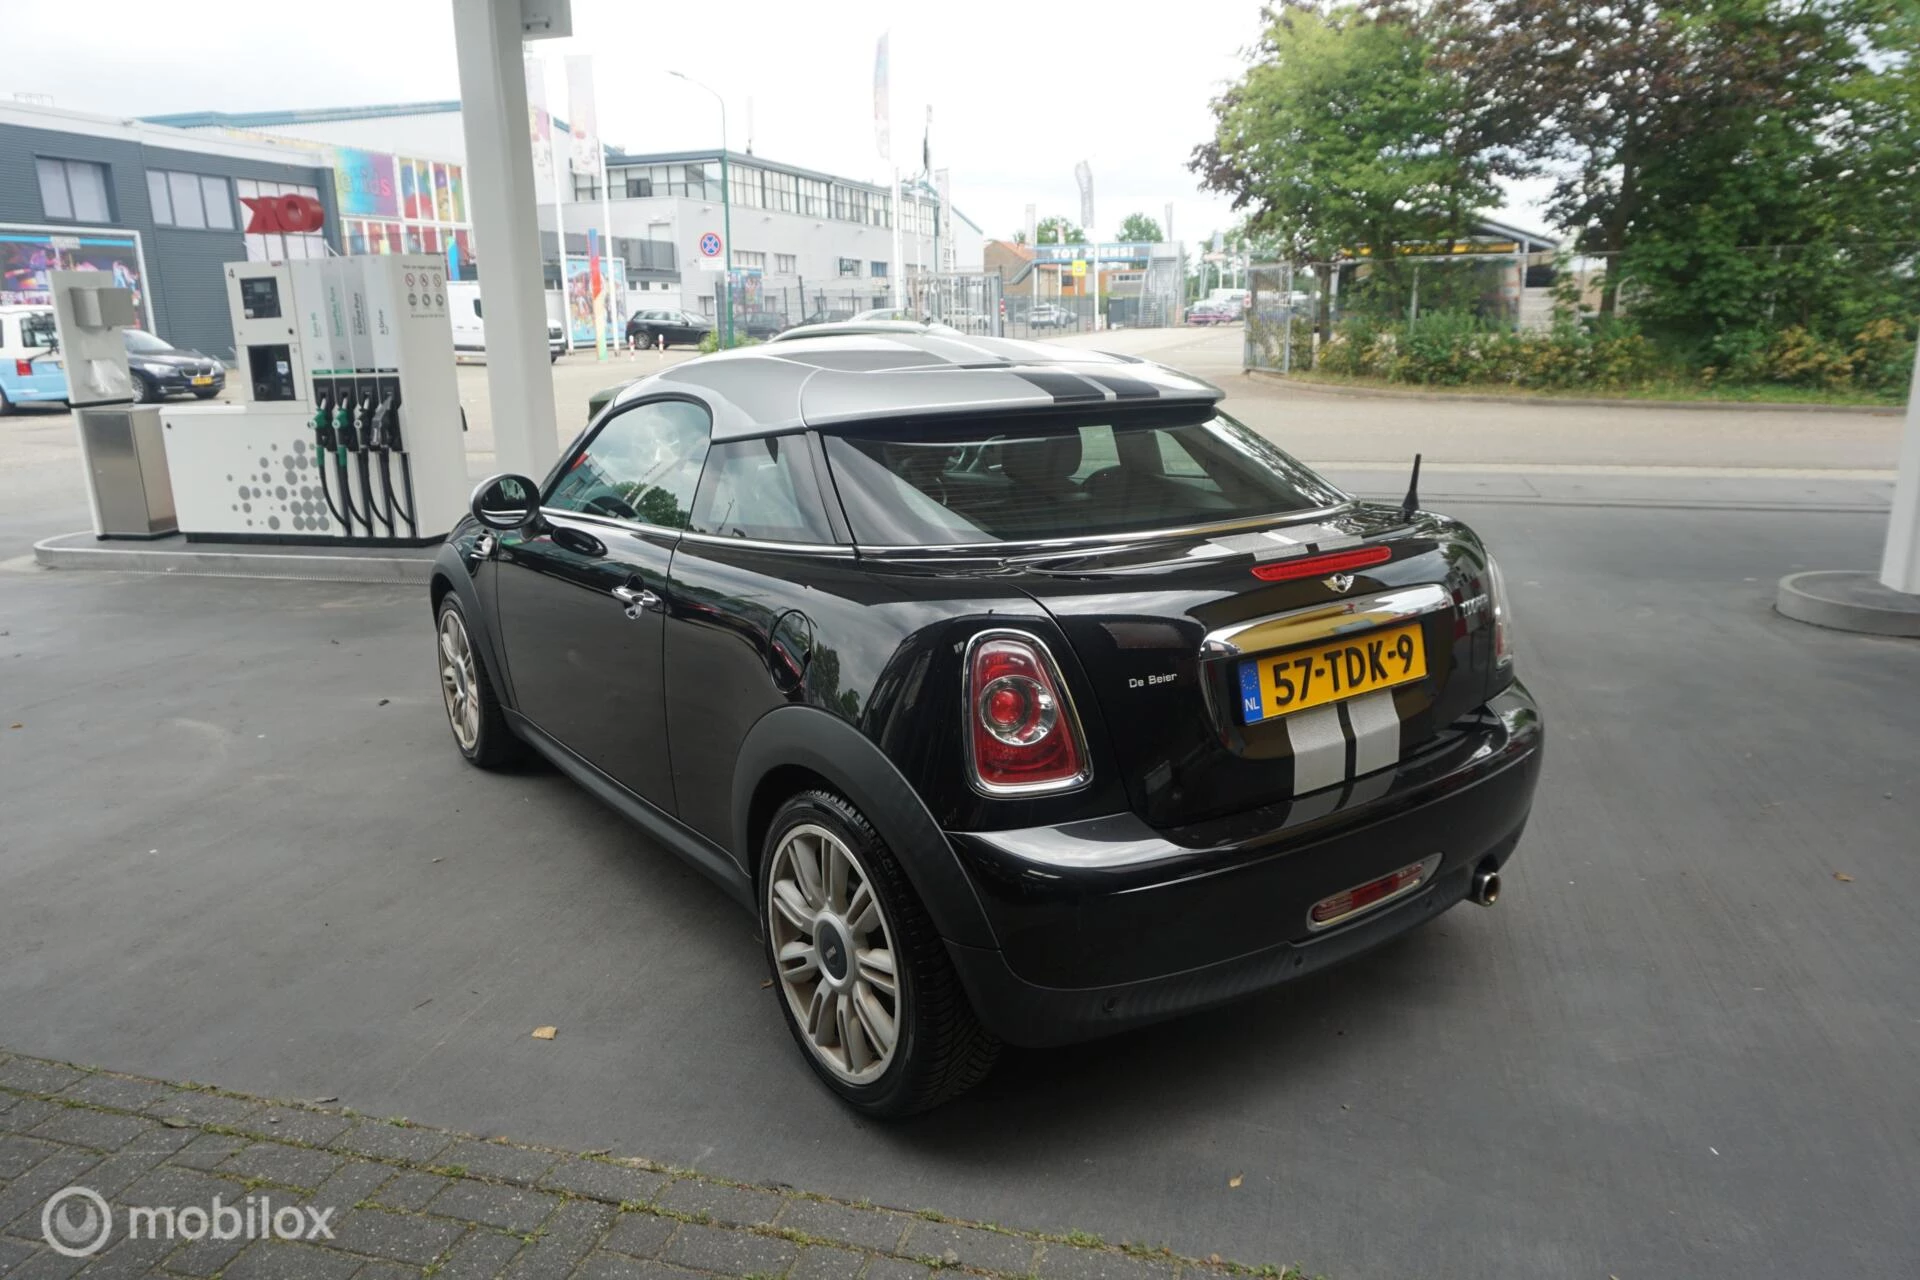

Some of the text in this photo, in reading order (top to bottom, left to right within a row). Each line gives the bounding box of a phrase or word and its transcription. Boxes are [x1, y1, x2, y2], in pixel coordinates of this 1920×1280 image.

[229, 268, 235, 279] 4
[1272, 634, 1415, 707] 57-TDK-9
[1128, 678, 1145, 689] De
[1244, 698, 1260, 712] NL
